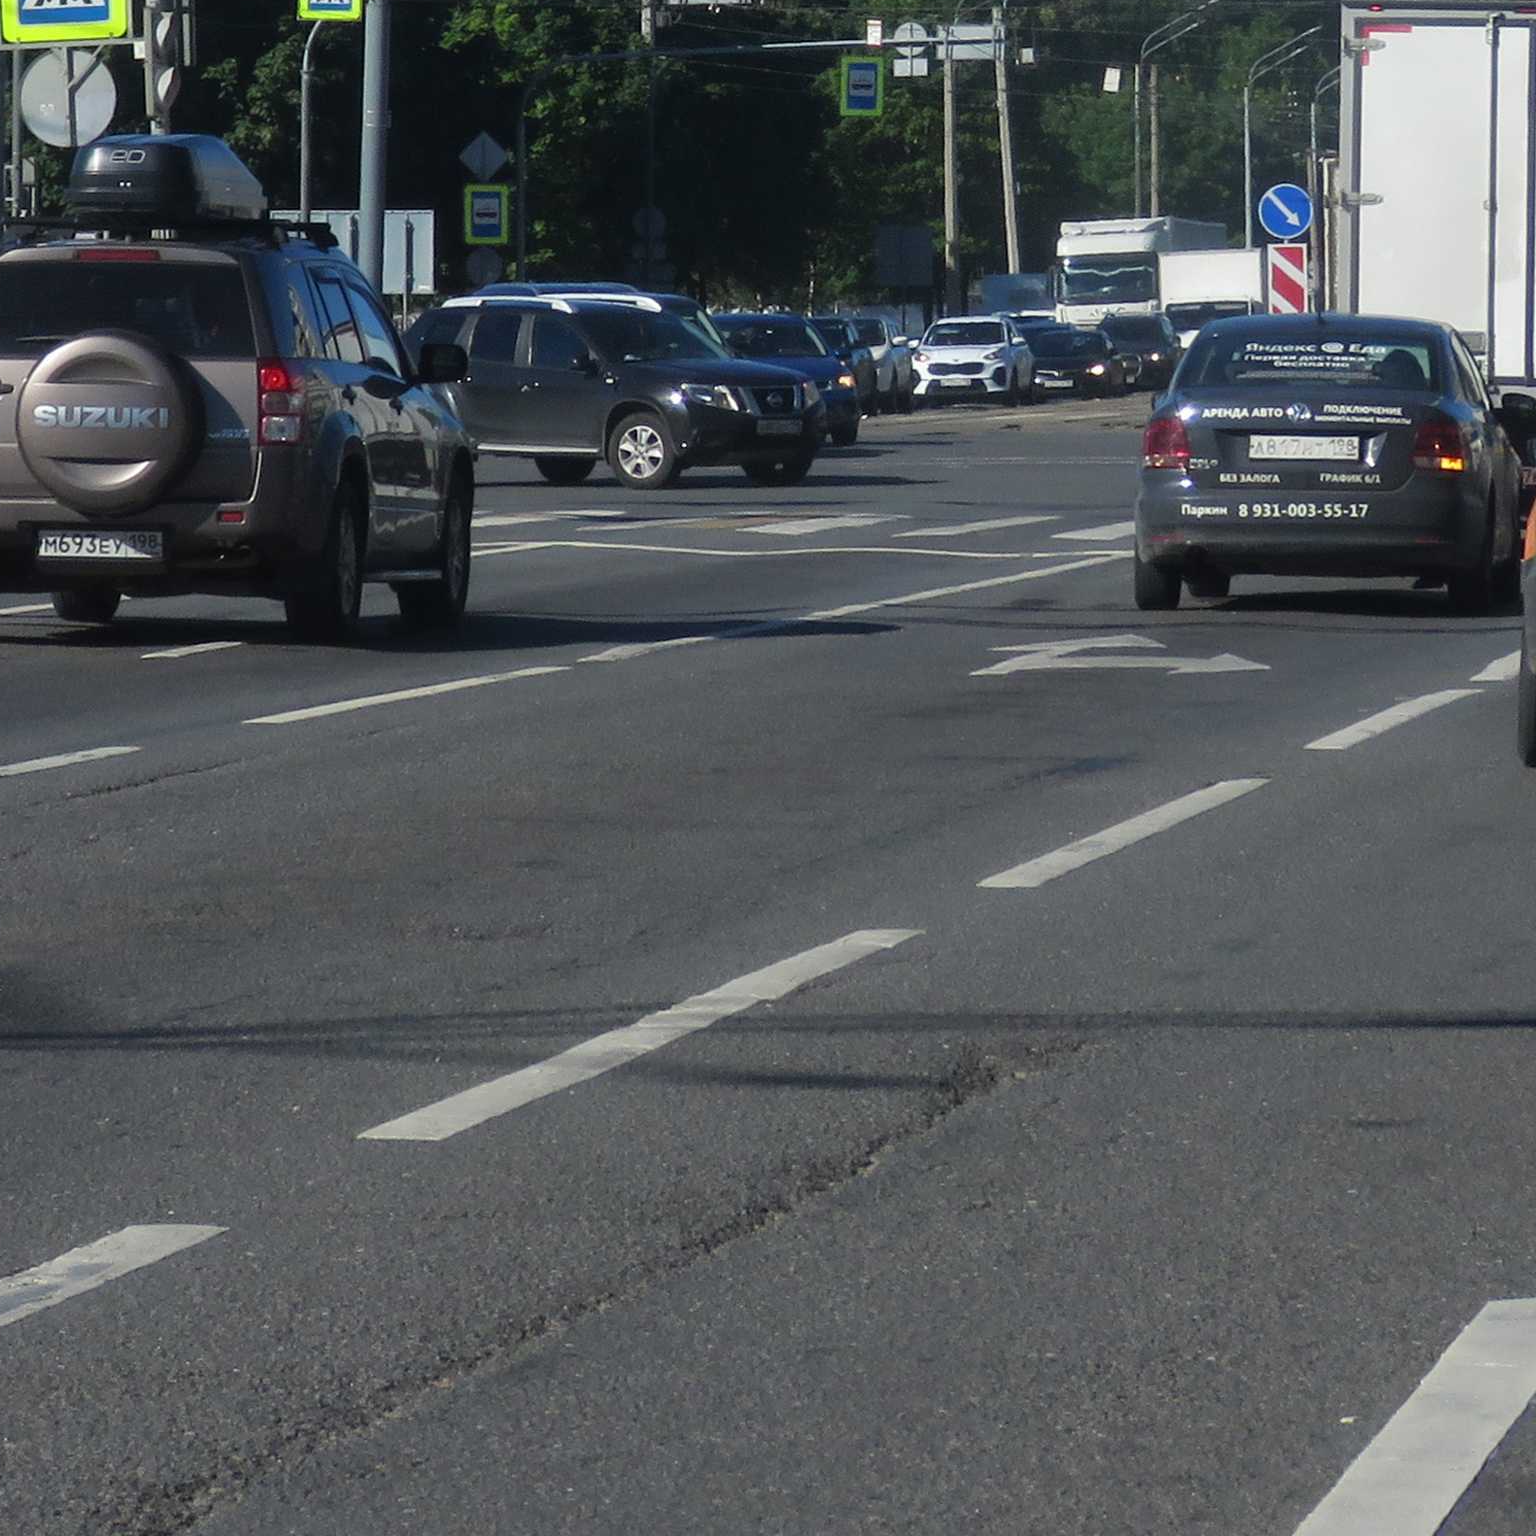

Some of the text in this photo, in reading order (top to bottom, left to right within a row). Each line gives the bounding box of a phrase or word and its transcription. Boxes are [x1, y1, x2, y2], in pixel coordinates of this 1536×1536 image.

[1245, 342, 1386, 355] Яндекс Еда
[1244, 353, 1366, 363] Первая доставка
[1272, 360, 1350, 369] бесплатно
[33, 404, 169, 429] SUZUKI
[1201, 407, 1284, 420] АРЕНДА АВТО
[1323, 403, 1403, 417] ПОДКЛЮЧЕНИЕ
[1219, 472, 1281, 484] БЕЗ ЗАЛОГА
[1319, 473, 1381, 484] ГРАФИК 6/1
[1181, 503, 1369, 519] Паркин 8 931-003-55-17
[43, 534, 124, 554] М693ЕУ
